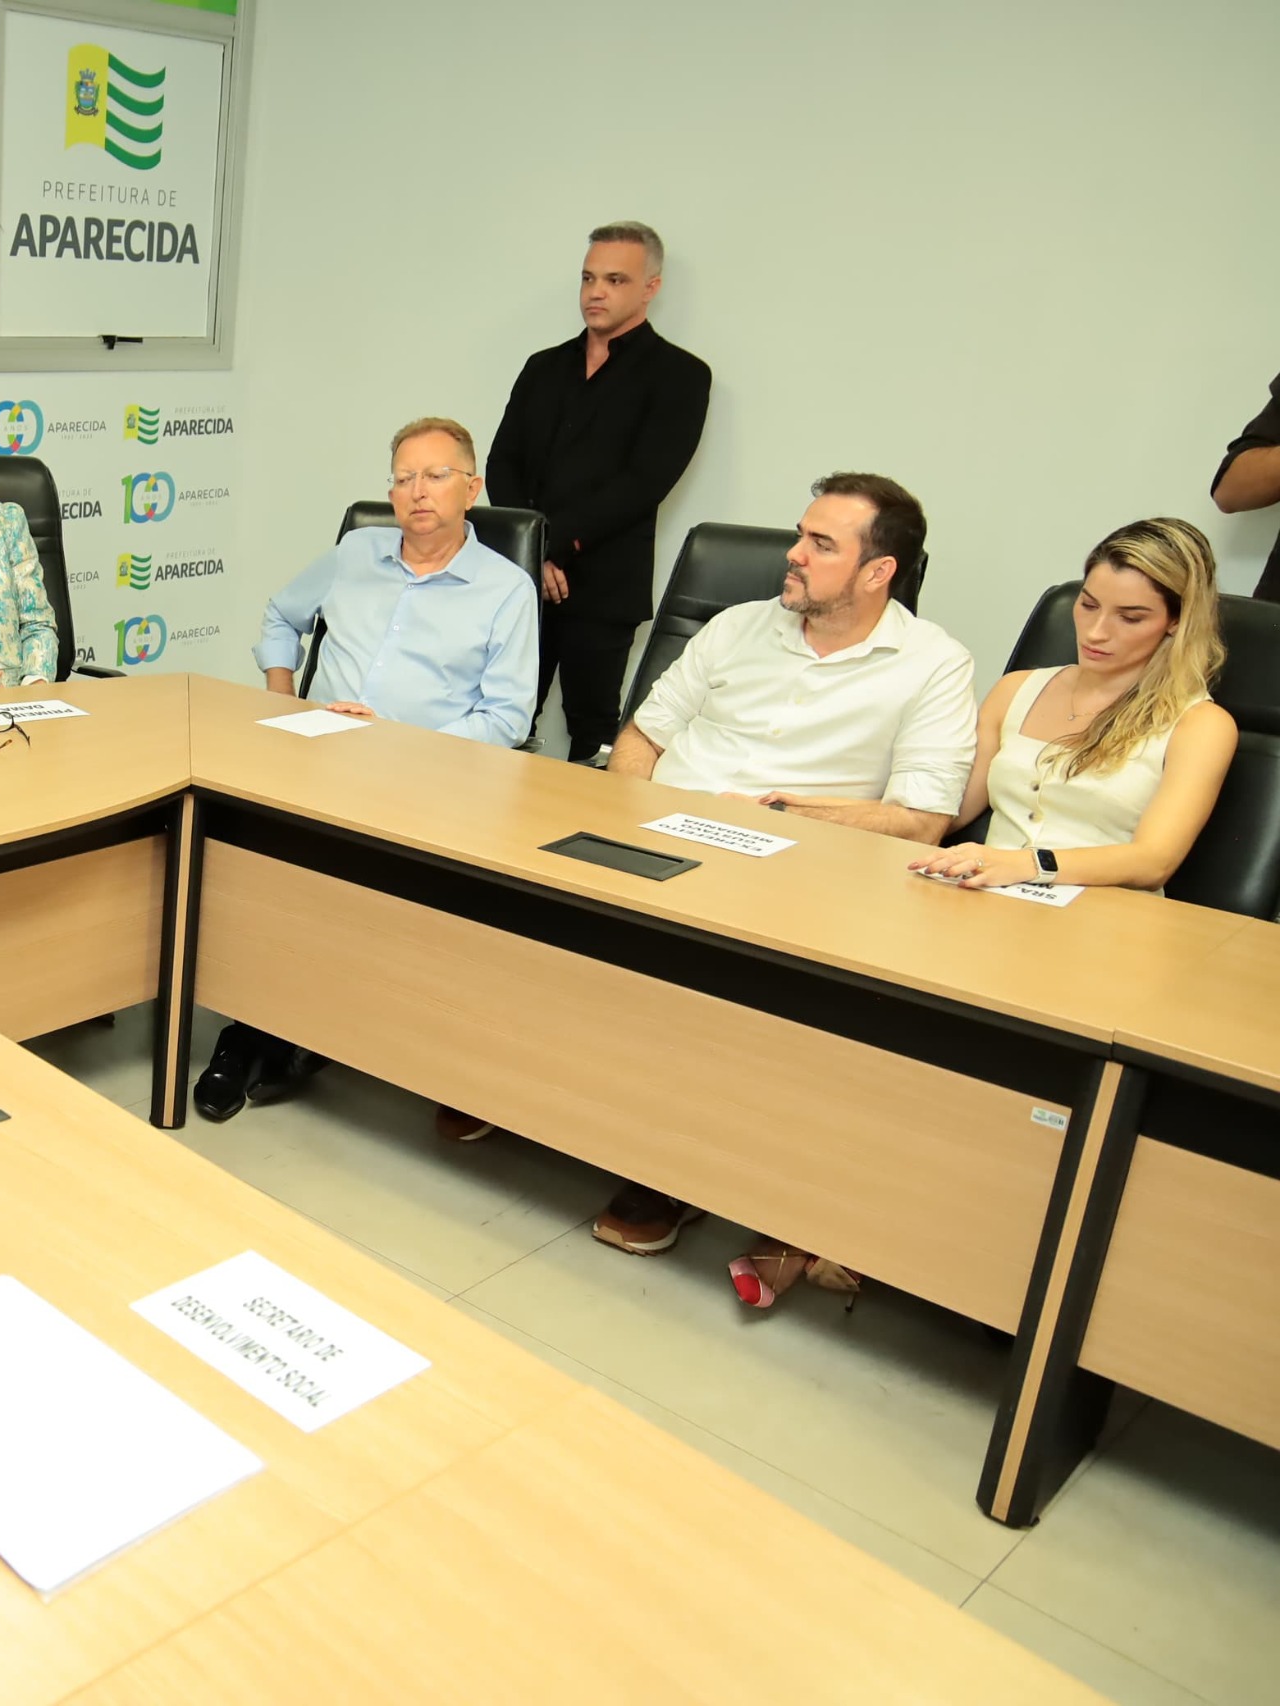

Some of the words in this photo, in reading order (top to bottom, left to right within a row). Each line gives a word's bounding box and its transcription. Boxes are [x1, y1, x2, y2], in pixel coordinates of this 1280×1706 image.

[43, 180, 150, 205] PREFEITURA
[157, 189, 177, 207] DE
[9, 213, 200, 264] APARECIDA
[47, 421, 106, 433] APARECIDA
[163, 418, 234, 437] APARECIDA
[121, 471, 176, 524] 100
[178, 487, 230, 502] APARECIDA
[61, 501, 102, 520] ECIDA
[69, 571, 100, 584] ECIDA
[154, 558, 225, 581] APARECIDA
[170, 625, 221, 641] APARECIDA
[11, 708, 74, 719] PRIMEIR
[658, 823, 763, 851] EX-PREFEITO
[680, 824, 756, 844] GUSTAVO
[684, 818, 774, 843] MENDANHA
[1017, 886, 1058, 900] SRA.
[242, 1296, 325, 1348] SECRETARIO
[313, 1343, 344, 1361] DE
[171, 1295, 288, 1374] DESENVOLVIMENTO
[276, 1369, 331, 1407] SOCIAL
